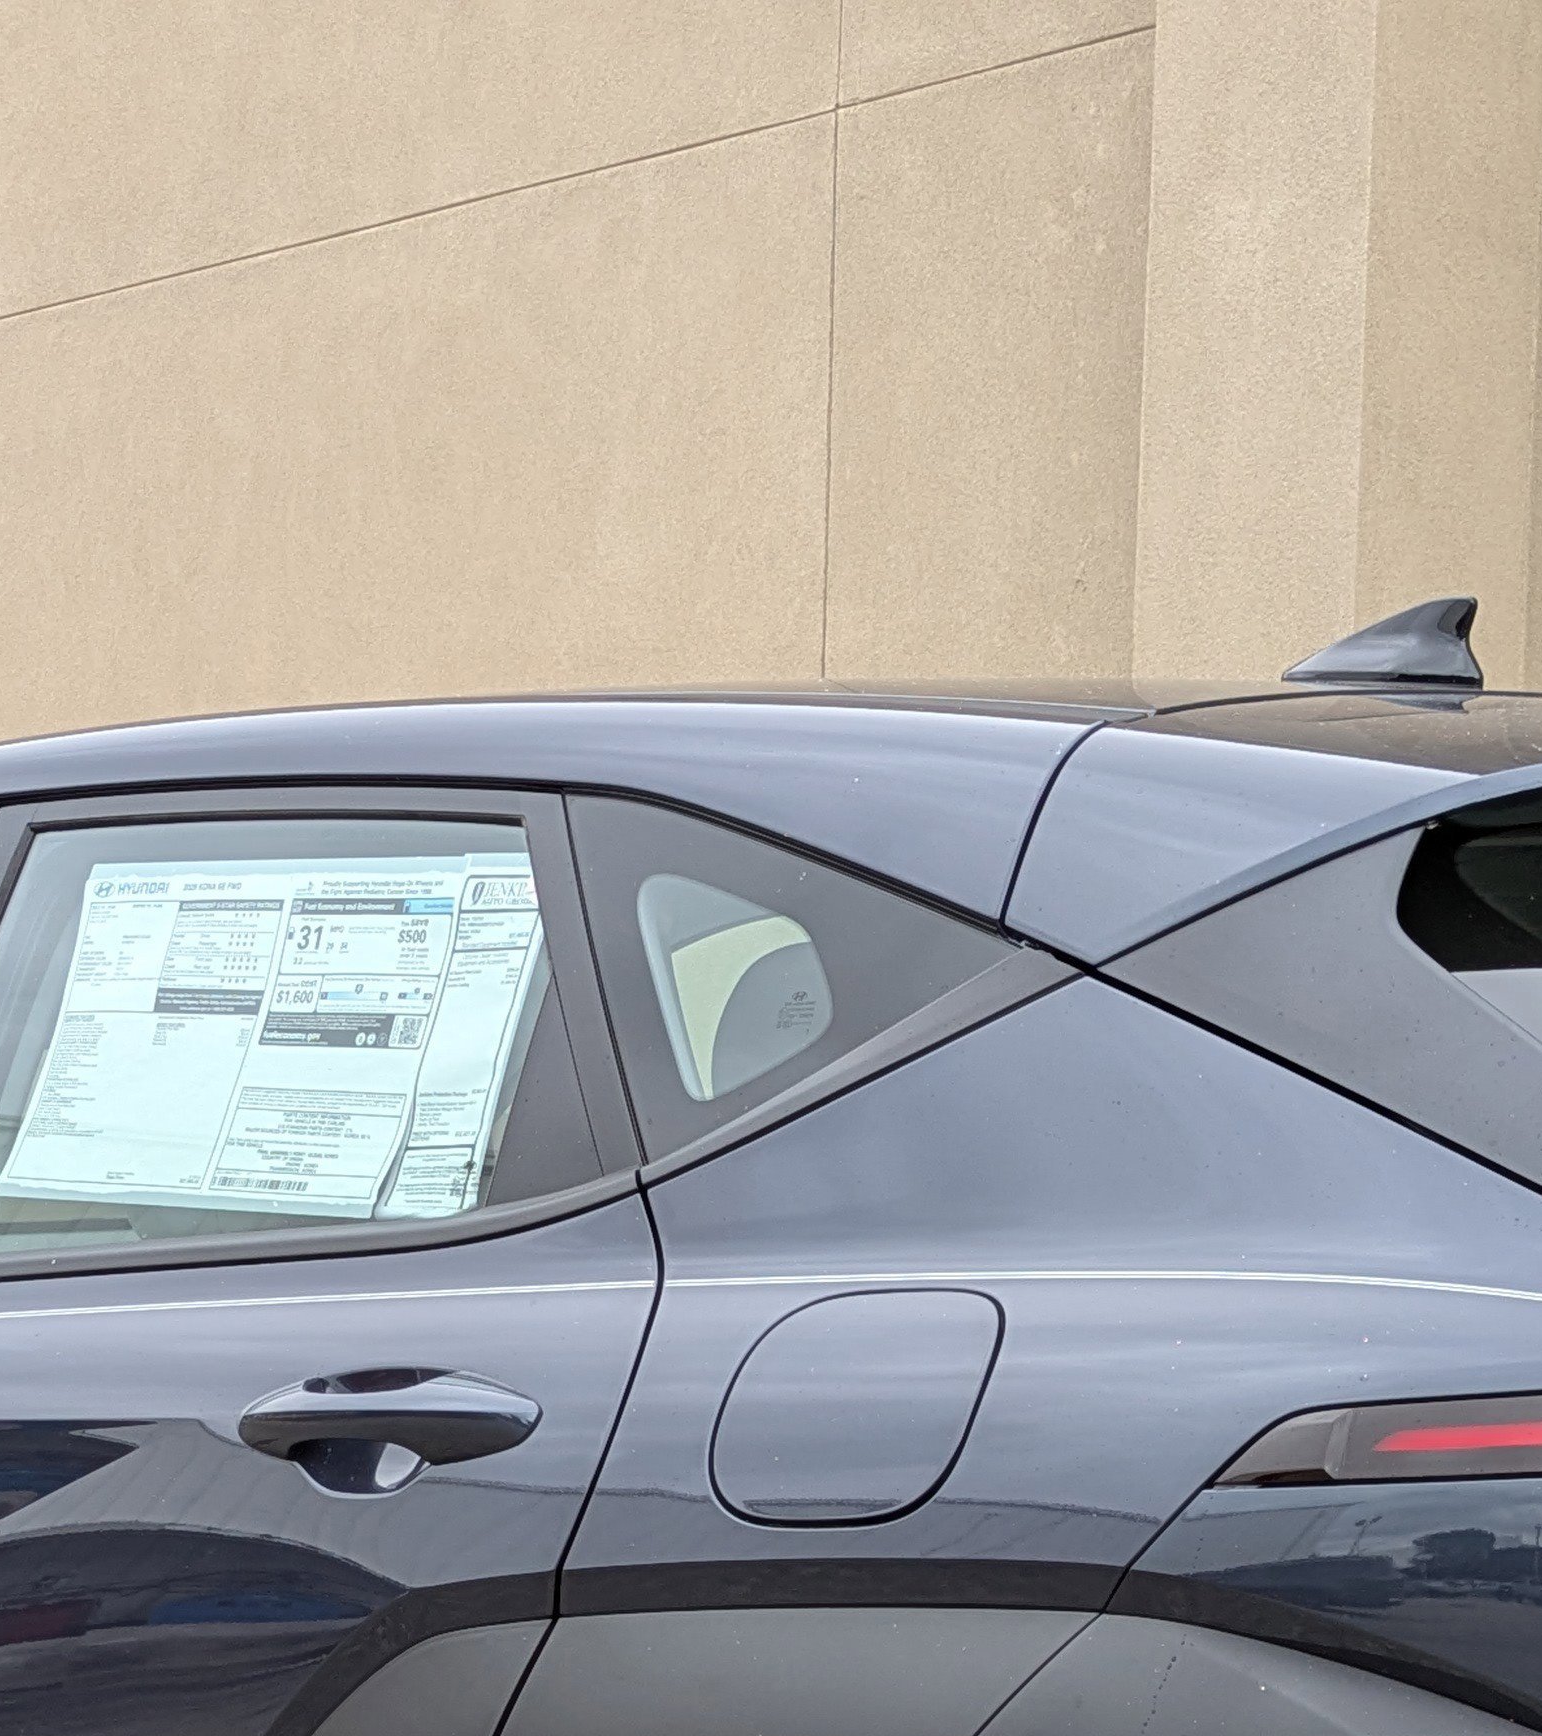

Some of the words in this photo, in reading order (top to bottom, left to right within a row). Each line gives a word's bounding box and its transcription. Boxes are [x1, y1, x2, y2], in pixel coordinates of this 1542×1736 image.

[117, 881, 170, 896] HYUNDAI
[297, 925, 324, 950] 31
[397, 930, 427, 943] $500
[276, 990, 314, 1004] $1,600
